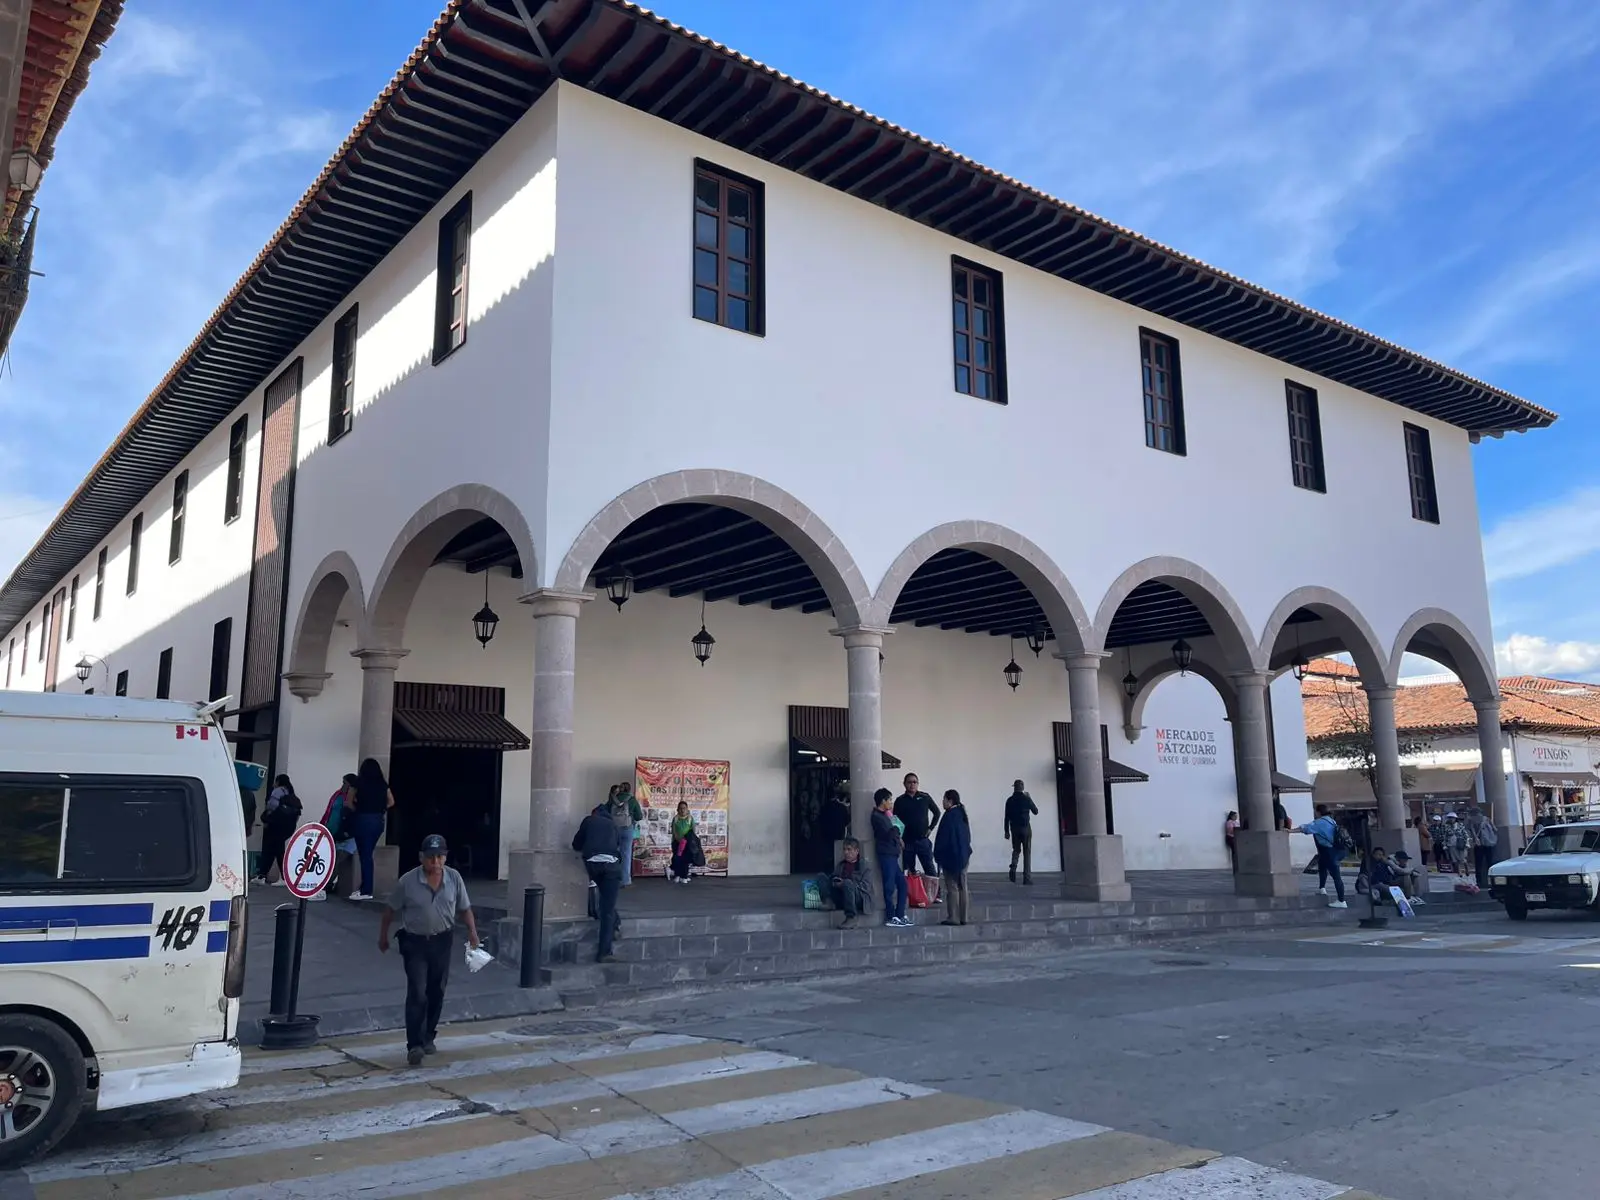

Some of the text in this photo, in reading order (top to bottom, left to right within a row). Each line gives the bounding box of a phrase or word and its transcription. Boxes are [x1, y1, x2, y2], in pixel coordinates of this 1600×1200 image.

[1156, 729, 1206, 741] MERCADO
[1156, 741, 1216, 755] PÁTZCUARO
[155, 905, 205, 952] 48
